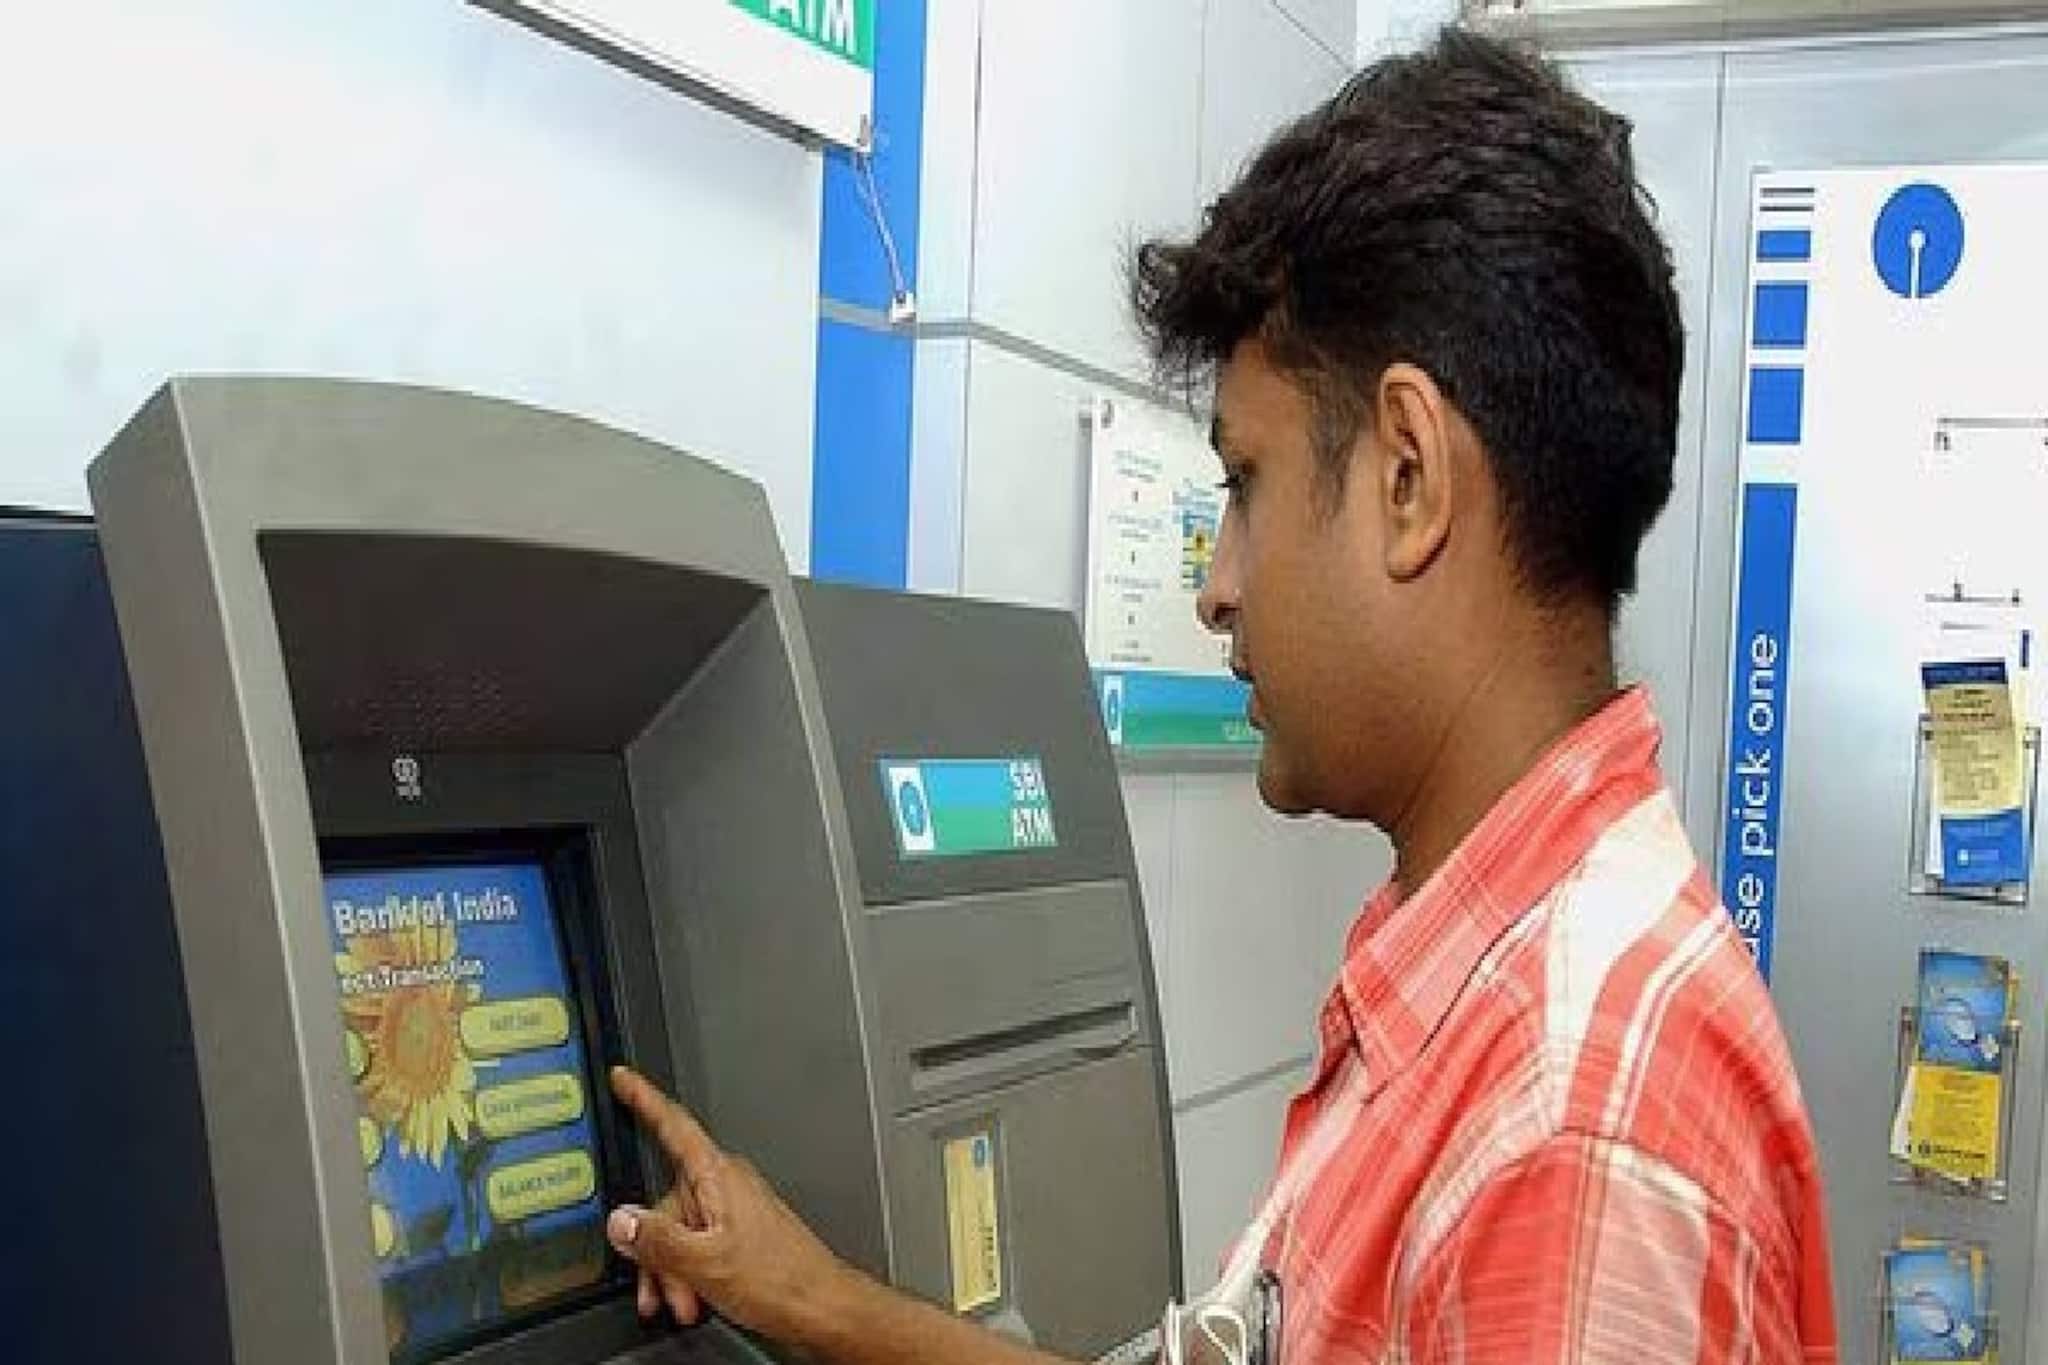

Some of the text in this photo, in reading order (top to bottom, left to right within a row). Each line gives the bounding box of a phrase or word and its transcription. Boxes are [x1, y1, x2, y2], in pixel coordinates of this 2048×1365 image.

[1748, 632, 1778, 736] one
[1012, 807, 1058, 848] ATM
[1734, 747, 1775, 856] pick
[453, 887, 519, 921] India
